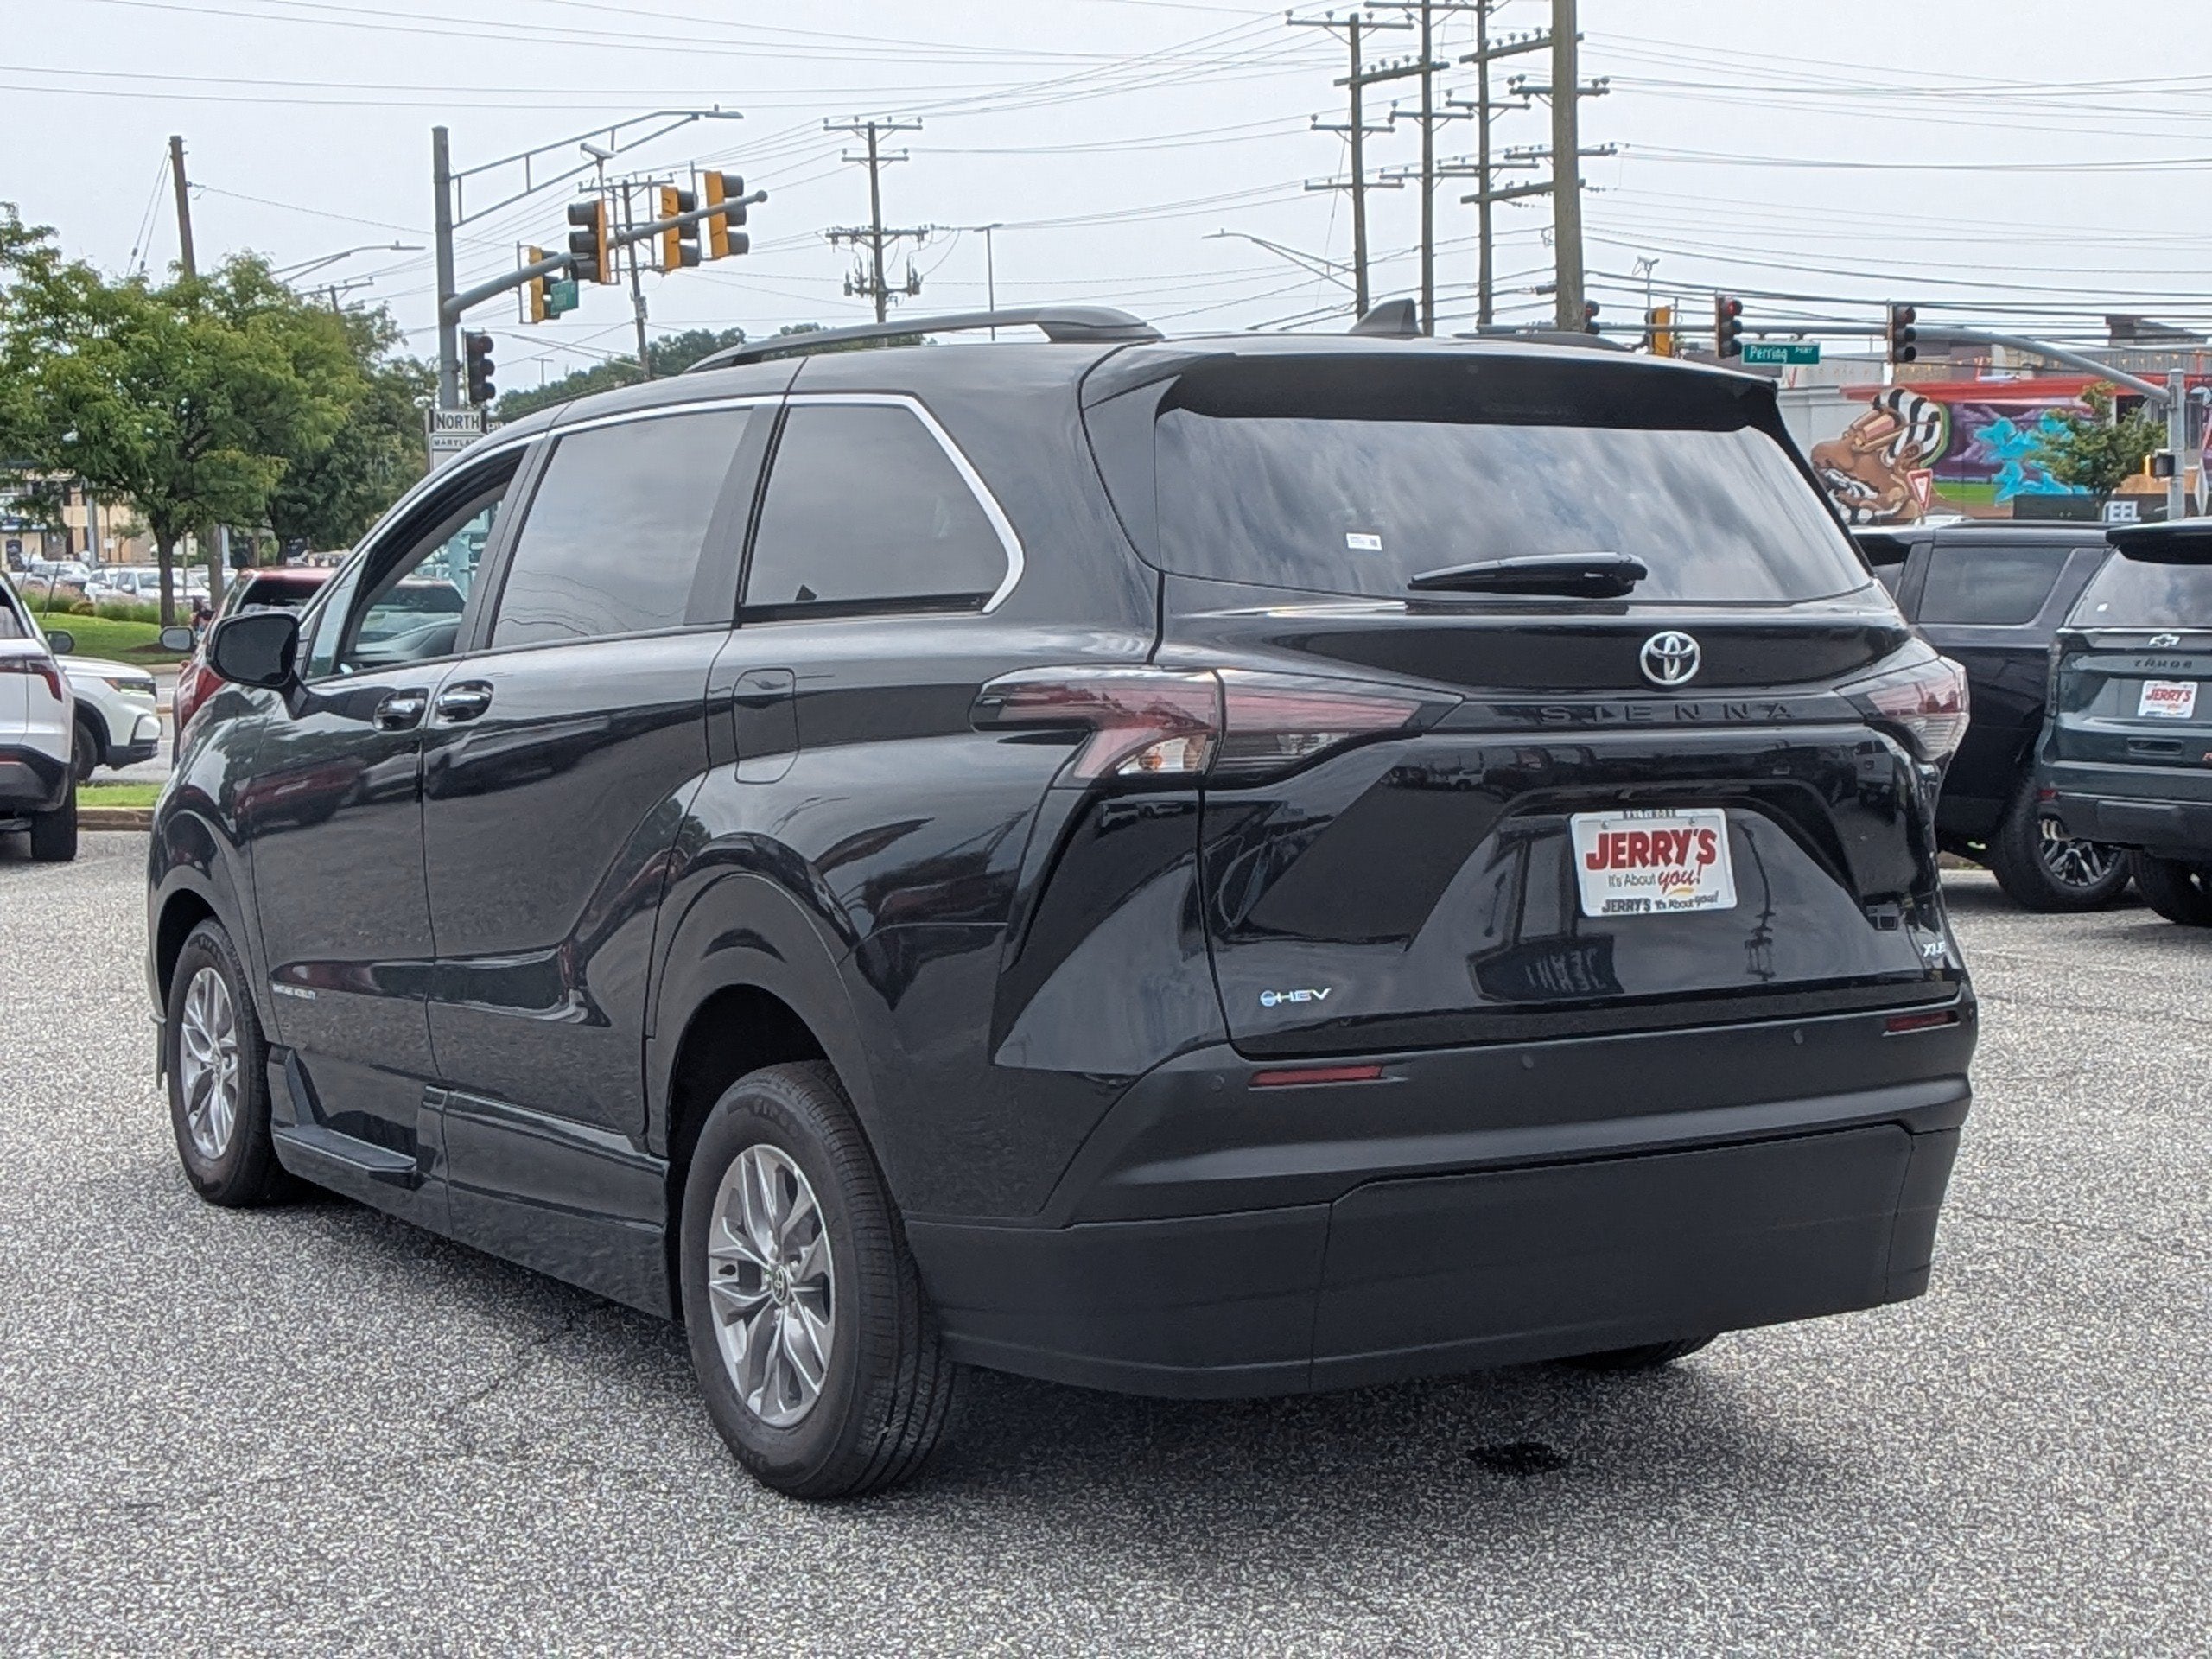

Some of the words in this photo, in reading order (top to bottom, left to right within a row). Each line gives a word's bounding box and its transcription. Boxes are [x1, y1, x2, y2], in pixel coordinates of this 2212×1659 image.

[1749, 346, 1788, 363] Perring
[436, 415, 480, 429] NORTH
[2145, 688, 2192, 702] JERRY'S
[1541, 702, 1794, 722] SIENNA
[1586, 829, 1718, 869] JERRY'S
[1624, 874, 1656, 887] About
[1658, 864, 1703, 895] you!
[1602, 898, 1651, 913] JERRY'S
